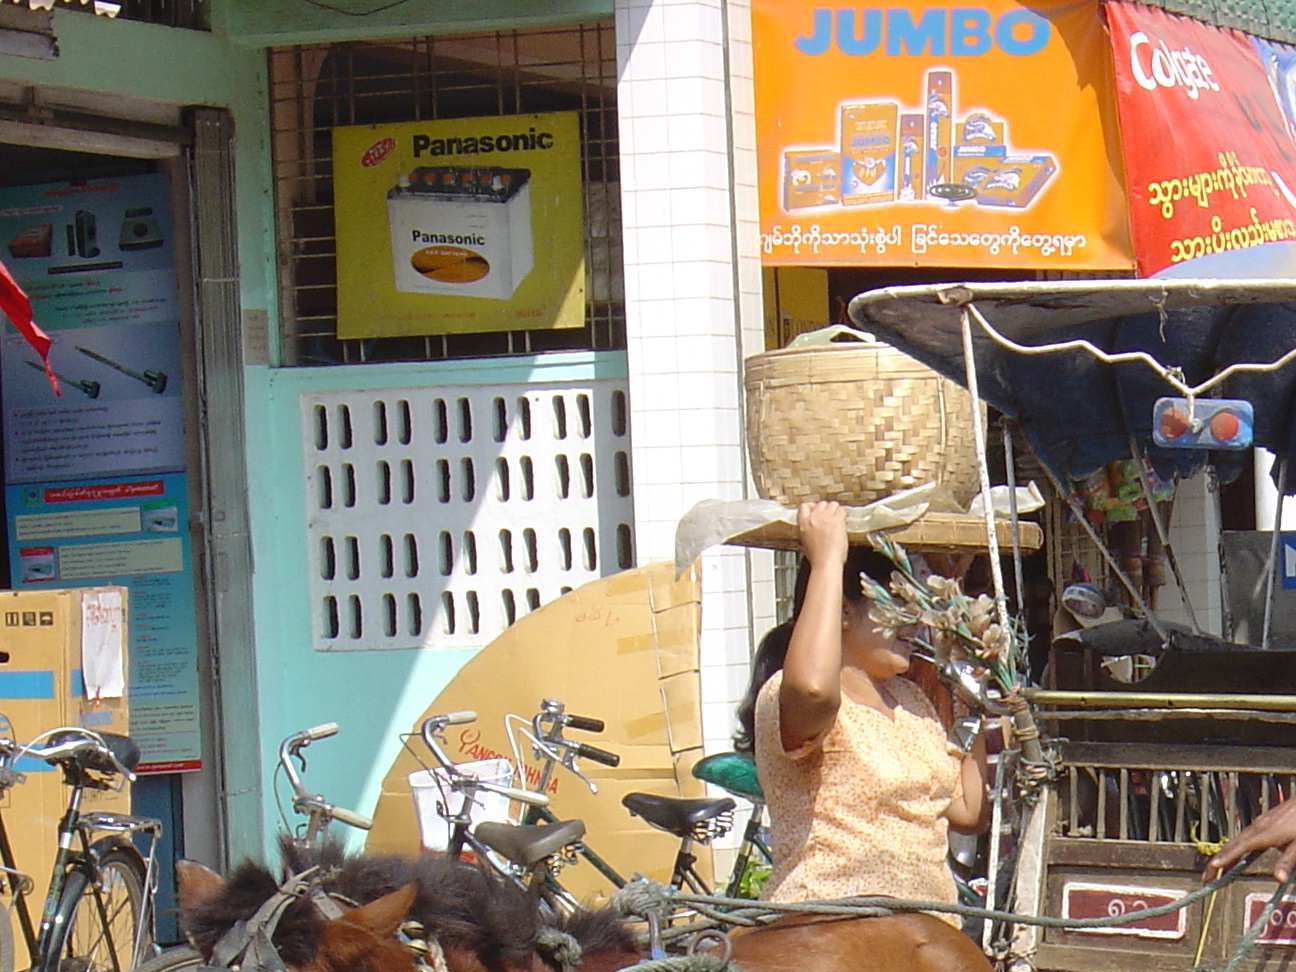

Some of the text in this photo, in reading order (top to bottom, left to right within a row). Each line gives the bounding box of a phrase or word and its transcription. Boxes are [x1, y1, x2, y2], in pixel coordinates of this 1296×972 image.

[793, 6, 1052, 58] JUMBO
[1129, 31, 1220, 100] Colgate
[412, 127, 554, 159] Panasonic
[411, 229, 486, 246] Panasonic
